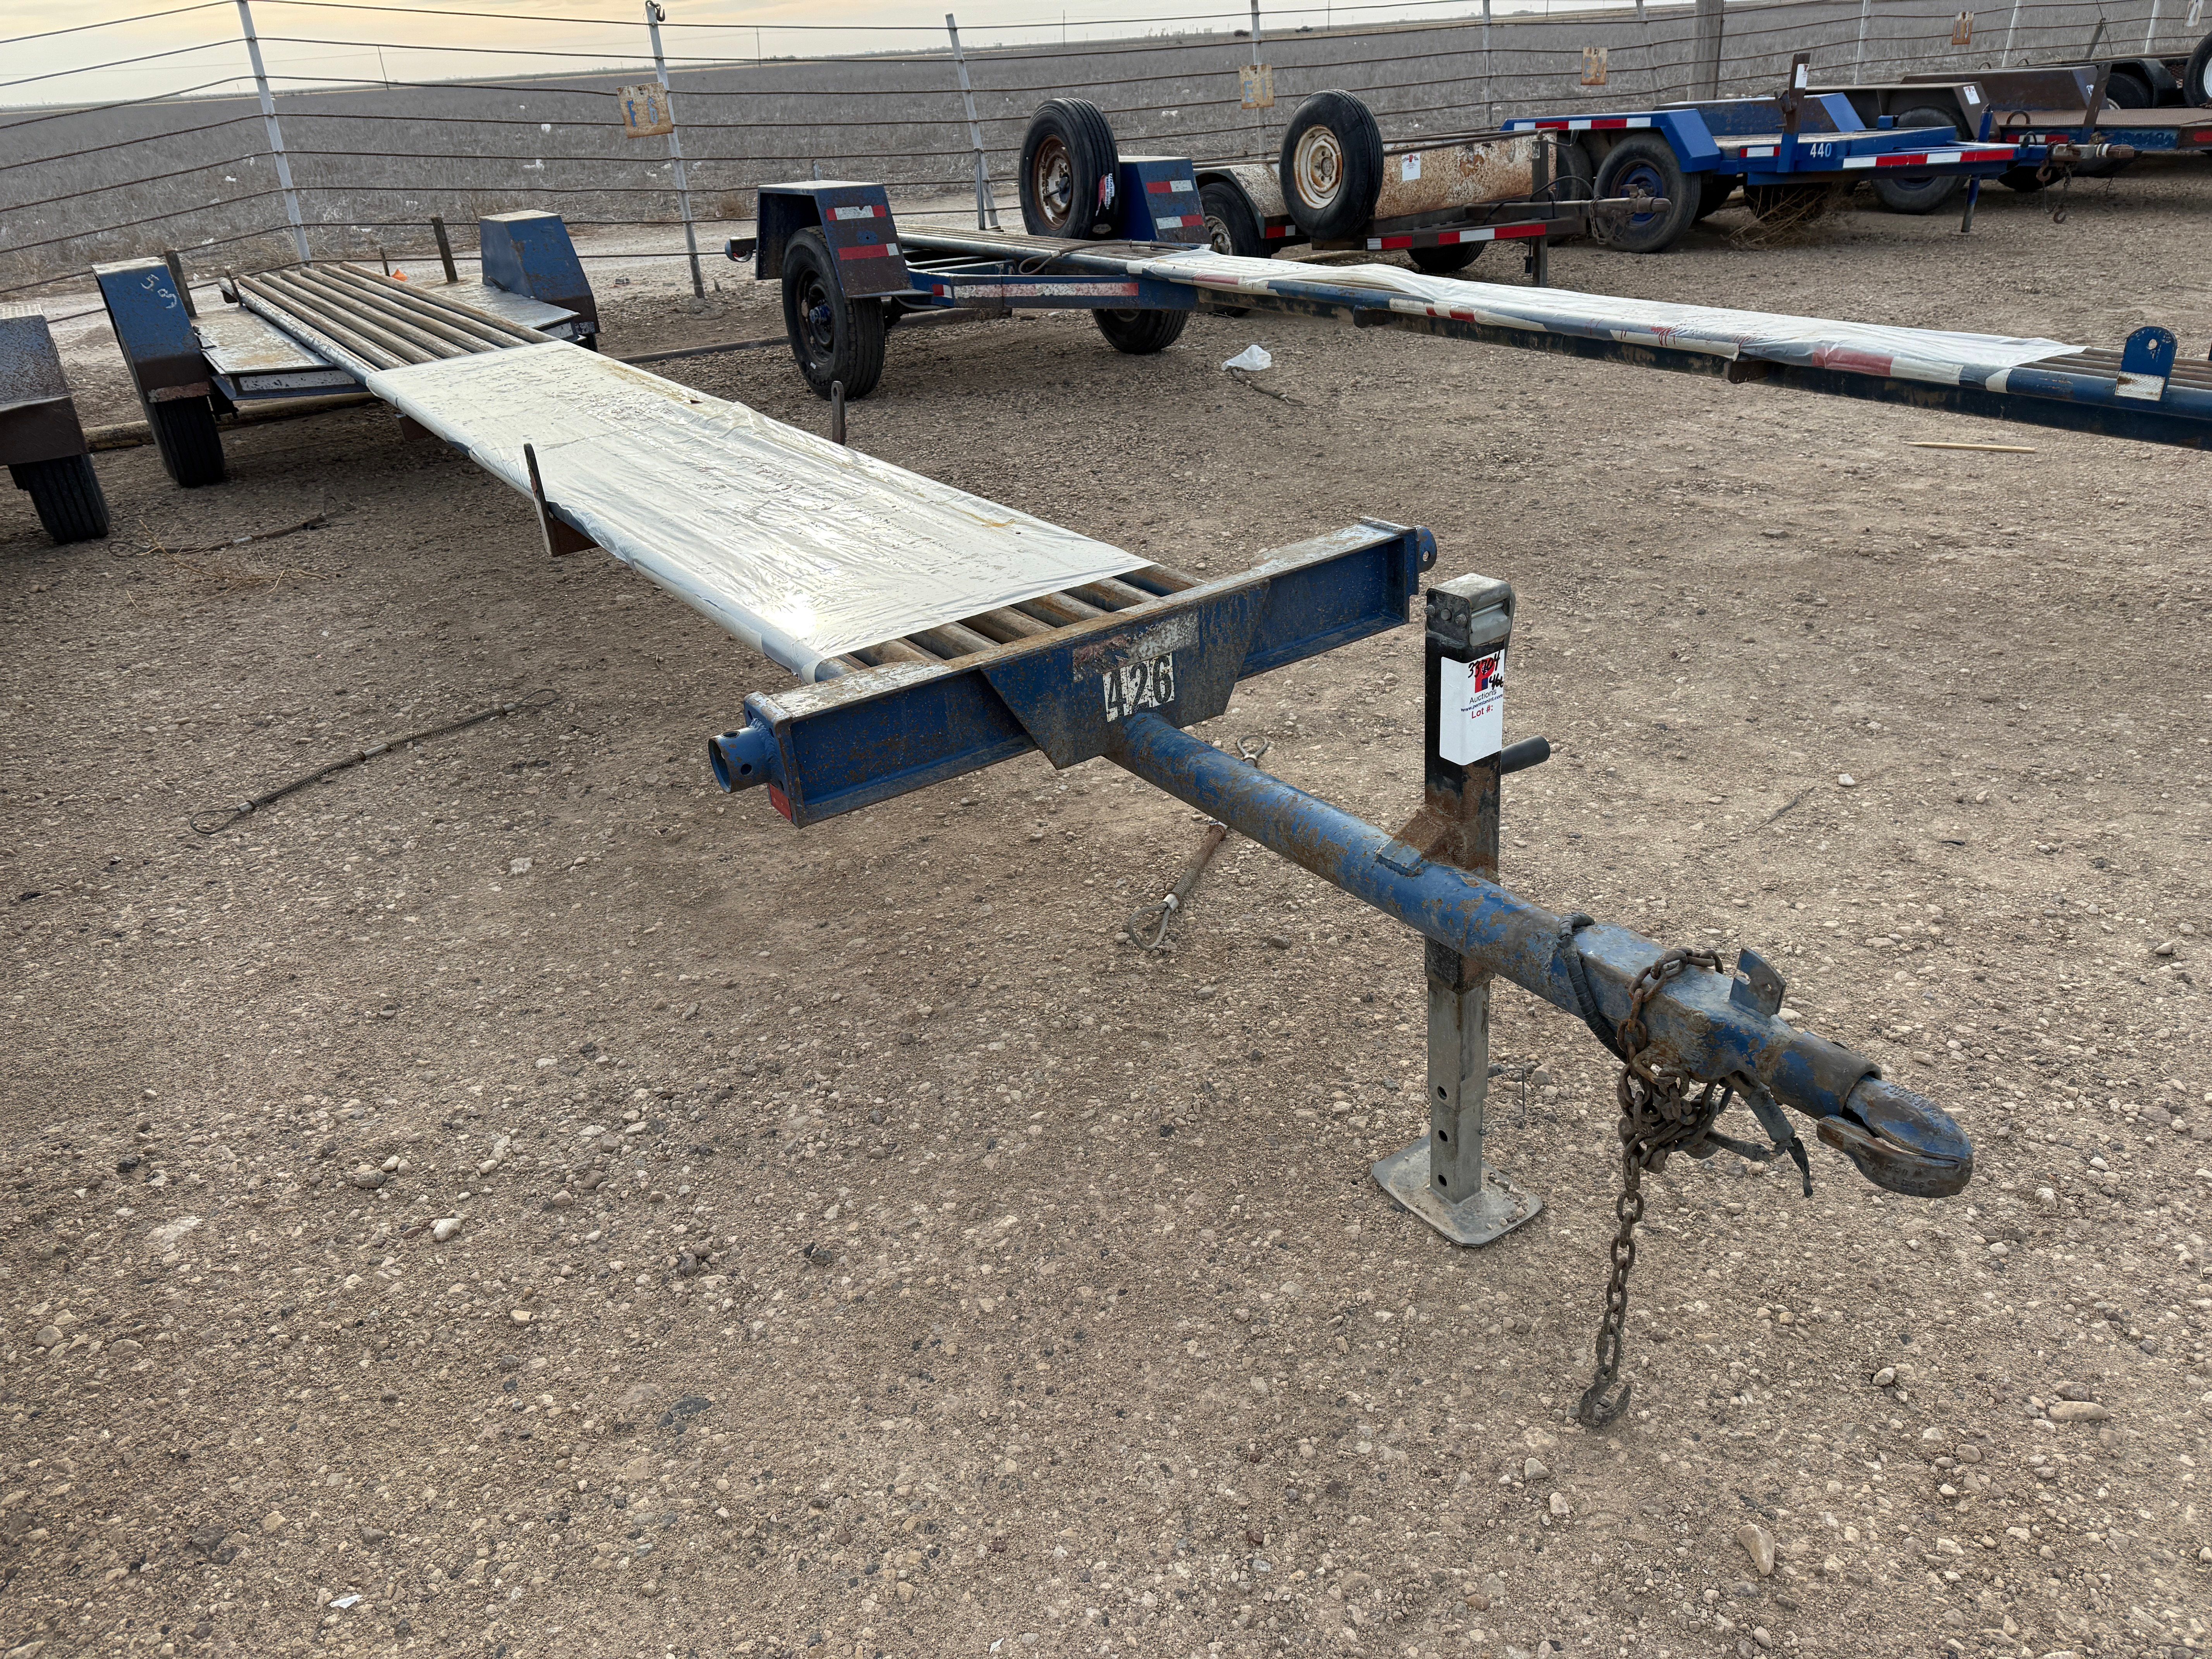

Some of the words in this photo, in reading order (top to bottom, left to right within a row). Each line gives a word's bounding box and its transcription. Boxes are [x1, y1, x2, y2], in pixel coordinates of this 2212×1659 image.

[1810, 143, 1832, 158] 440
[1107, 655, 1172, 718] 426
[1469, 689, 1497, 704] Auctions
[1472, 708, 1484, 719] Lot
[1486, 705, 1493, 713] #:
